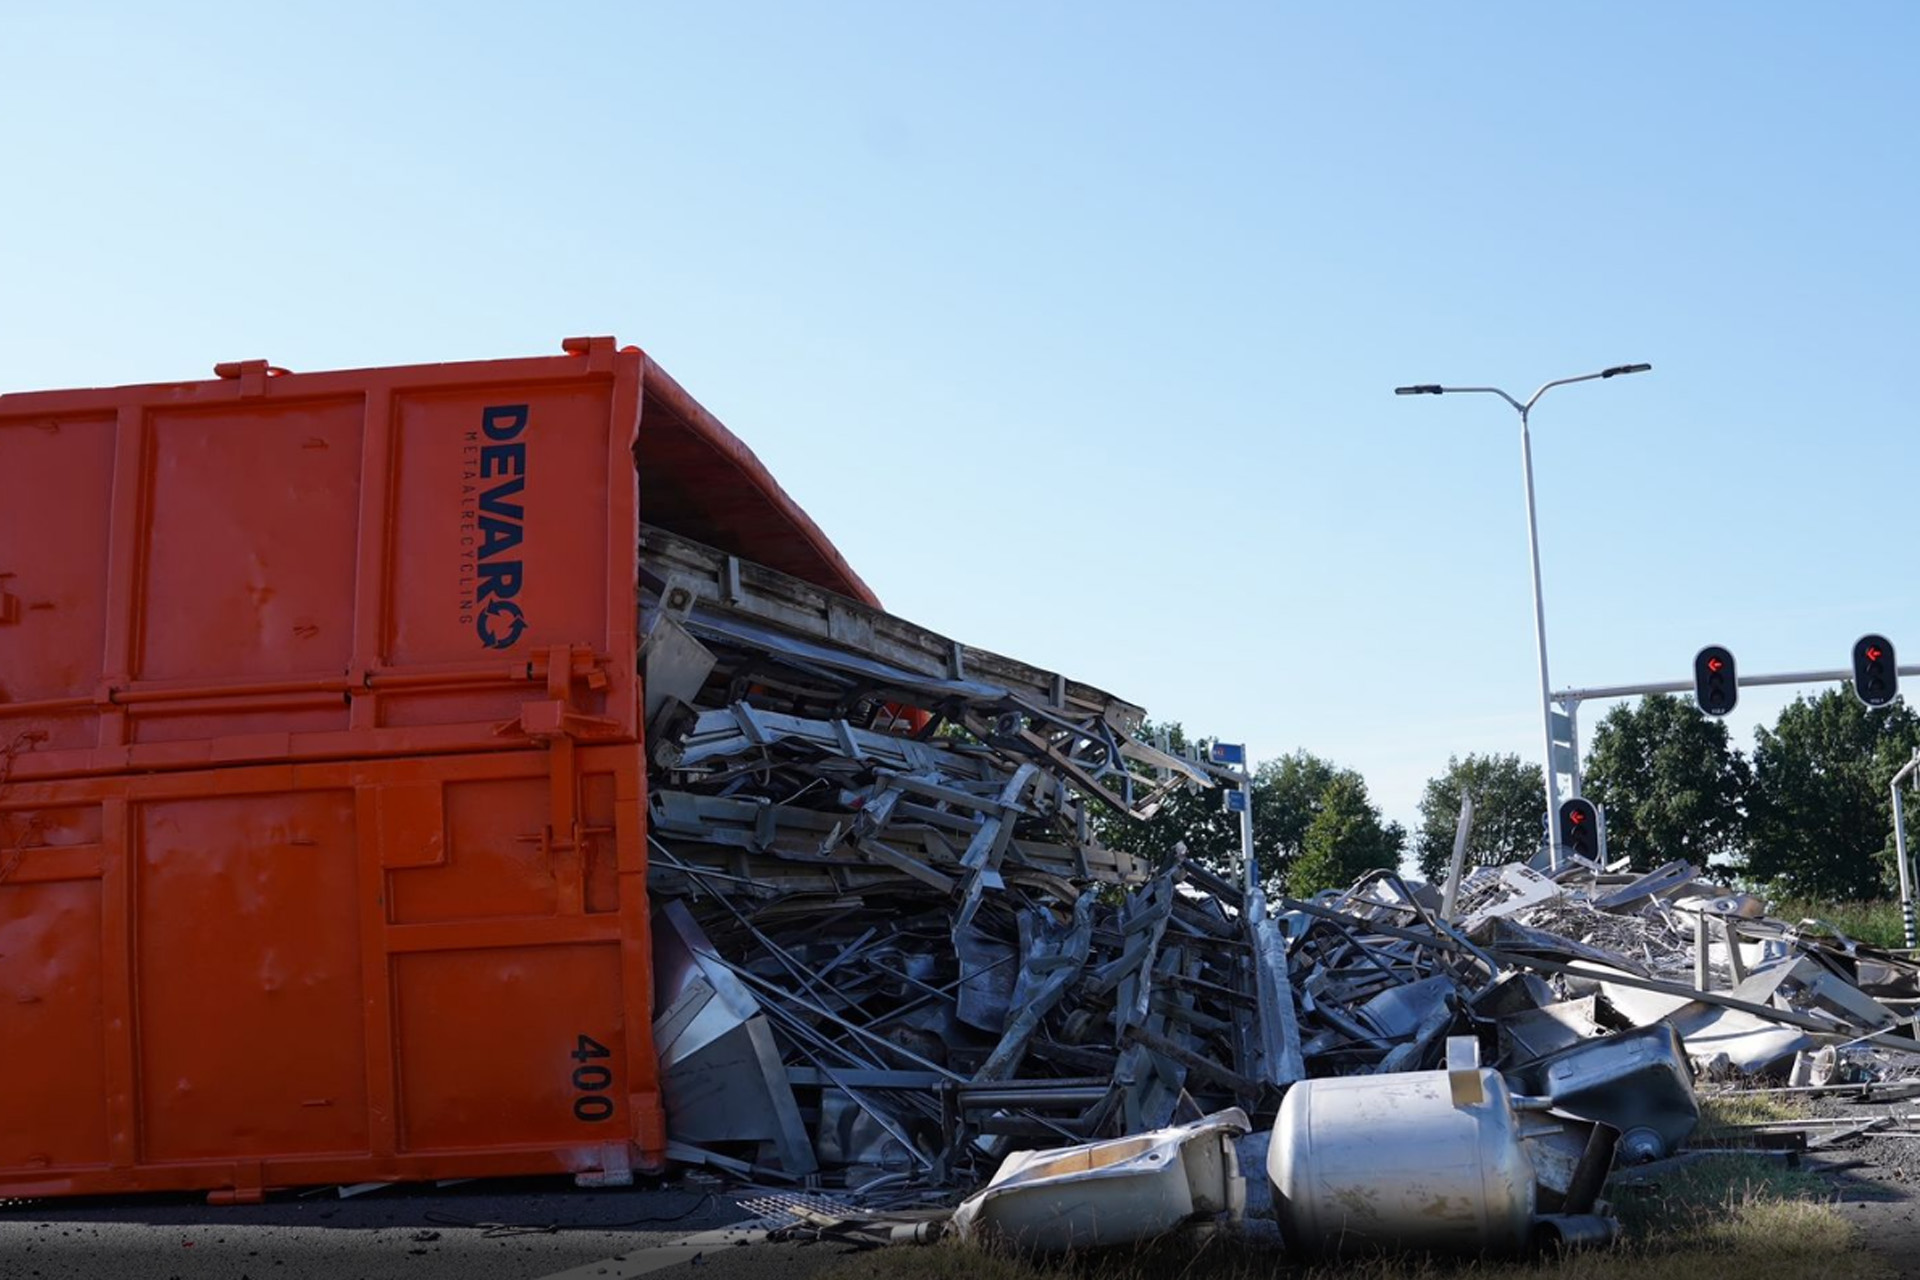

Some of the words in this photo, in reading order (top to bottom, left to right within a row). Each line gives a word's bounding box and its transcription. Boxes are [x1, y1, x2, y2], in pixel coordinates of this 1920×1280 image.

[459, 431, 478, 624] METAALRECYCLING
[476, 404, 529, 649] DEVARO
[571, 1034, 613, 1121] 400
